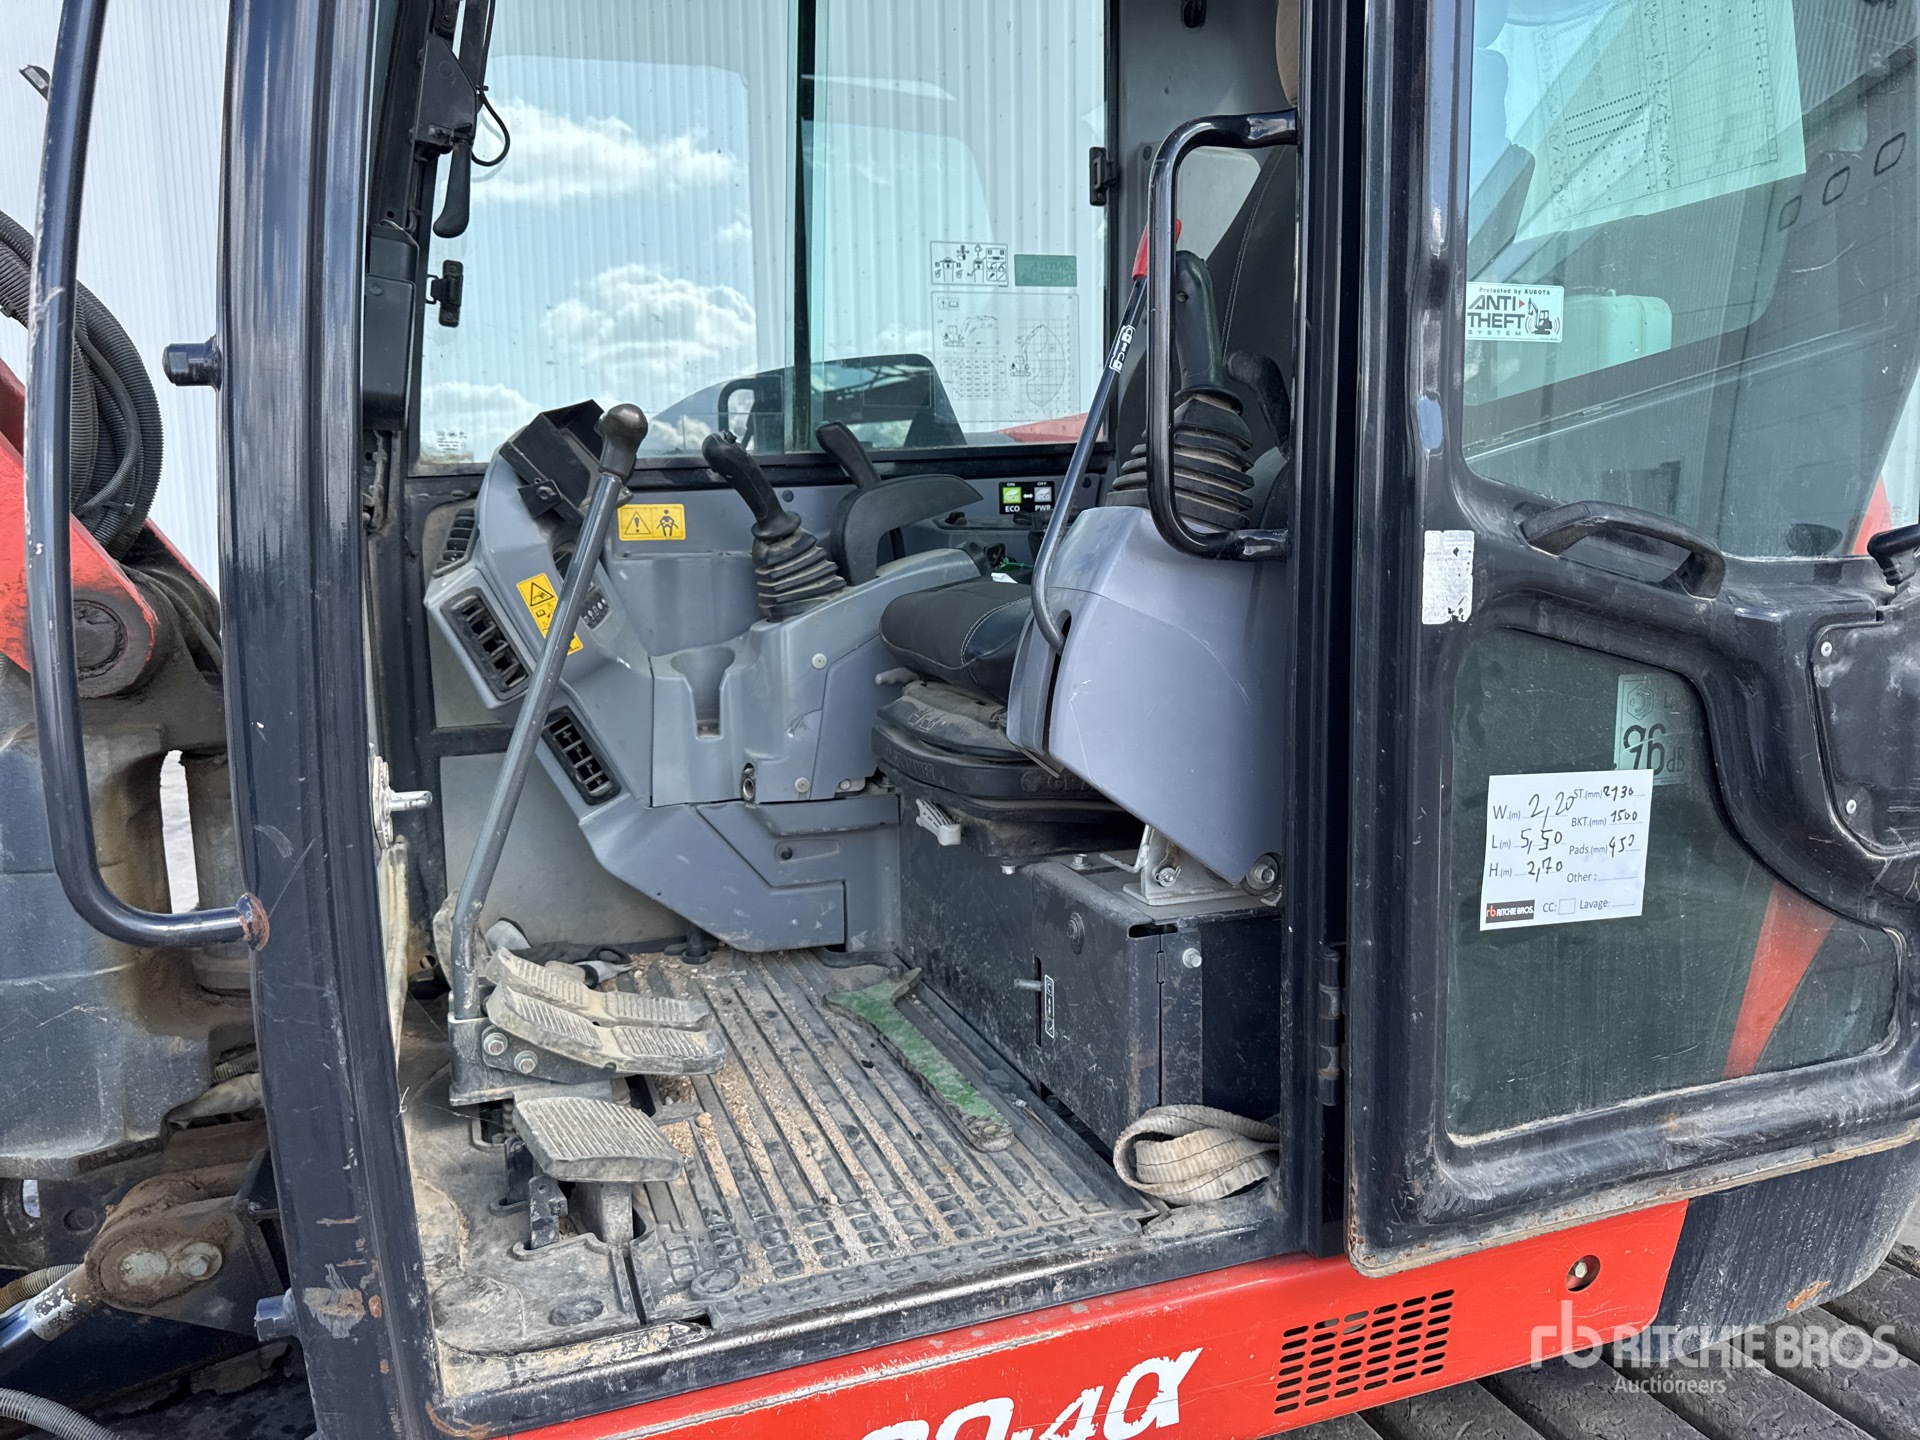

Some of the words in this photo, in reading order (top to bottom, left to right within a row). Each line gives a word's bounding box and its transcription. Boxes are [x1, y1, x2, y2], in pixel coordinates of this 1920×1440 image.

[1467, 294, 1516, 311] ANTI
[1467, 312, 1525, 329] THEFT
[1004, 505, 1021, 513] ECO
[1034, 504, 1051, 512] PWR
[1623, 722, 1667, 776] 96
[1610, 808, 1638, 823] 1500
[1527, 856, 1563, 882] 2,70
[1496, 906, 1517, 917] RITCHIE
[1542, 902, 1557, 913] CC:
